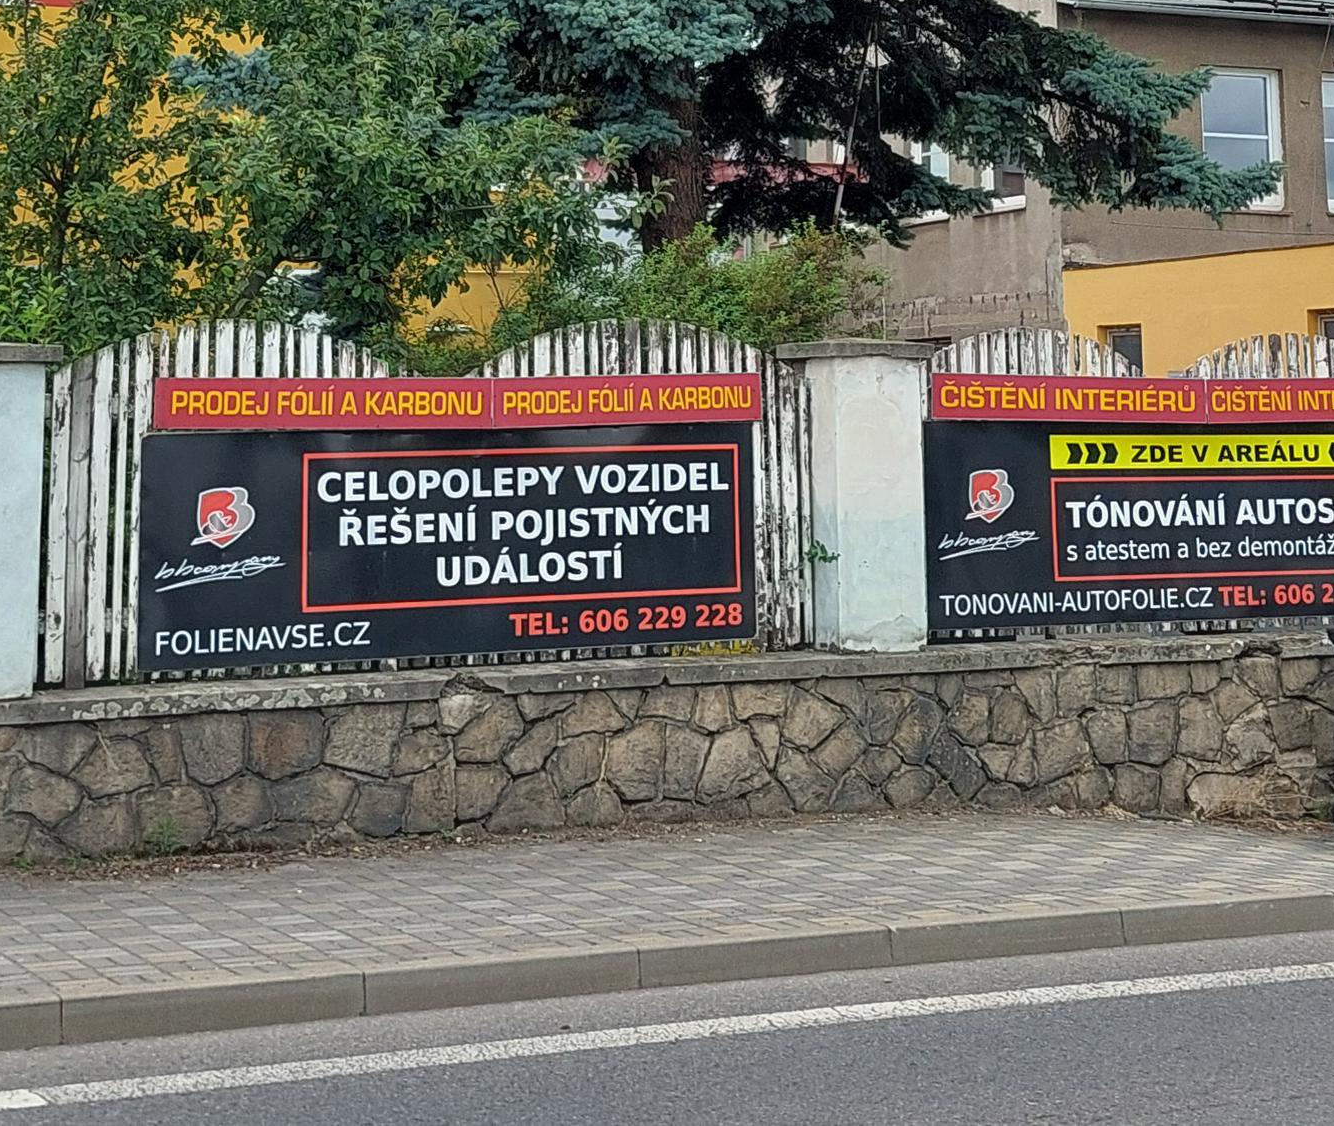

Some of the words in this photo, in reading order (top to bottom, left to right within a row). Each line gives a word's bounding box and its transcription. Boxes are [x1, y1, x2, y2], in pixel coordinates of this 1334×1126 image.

[171, 390, 270, 416] PRODEJ
[277, 385, 335, 416] FÓLIÍ
[339, 391, 358, 416] A
[365, 391, 482, 416] KARBONU
[503, 389, 582, 415] PRODEJ
[588, 382, 634, 413] FÓLIÍ
[639, 388, 654, 411] A
[658, 385, 752, 411] KARBONU
[940, 380, 1046, 410] ČIŠTĚNÍ
[1055, 384, 1196, 412] INTERIÉRŮ
[1211, 385, 1292, 412] ČIŠTĚNÍ
[1131, 444, 1183, 463] ZDE
[1191, 444, 1209, 463] V
[1217, 439, 1320, 462] AREÁLU
[317, 465, 565, 503] CELOPOLEPY
[573, 462, 730, 495] VOZIDEL
[339, 504, 477, 547] ŘEŠENÍ
[491, 498, 710, 544] POJISTNÝCH
[1065, 492, 1226, 529] TÓNOVÁNÍ
[436, 541, 623, 587] UDÁLOSTÍ
[1066, 544, 1079, 562] s
[1085, 539, 1170, 561] atestem
[1177, 542, 1189, 559] a
[1195, 537, 1232, 559] bez
[938, 586, 1214, 616] TONOVANI-AUTOFOLIE.CZ
[1219, 585, 1265, 607] TEL:
[1273, 583, 1315, 605] 606
[509, 611, 569, 636] TEL:
[579, 608, 629, 633] 606
[638, 605, 687, 630] 229
[695, 602, 743, 627] 228
[155, 621, 371, 656] FOLIENAVSE.CZ
